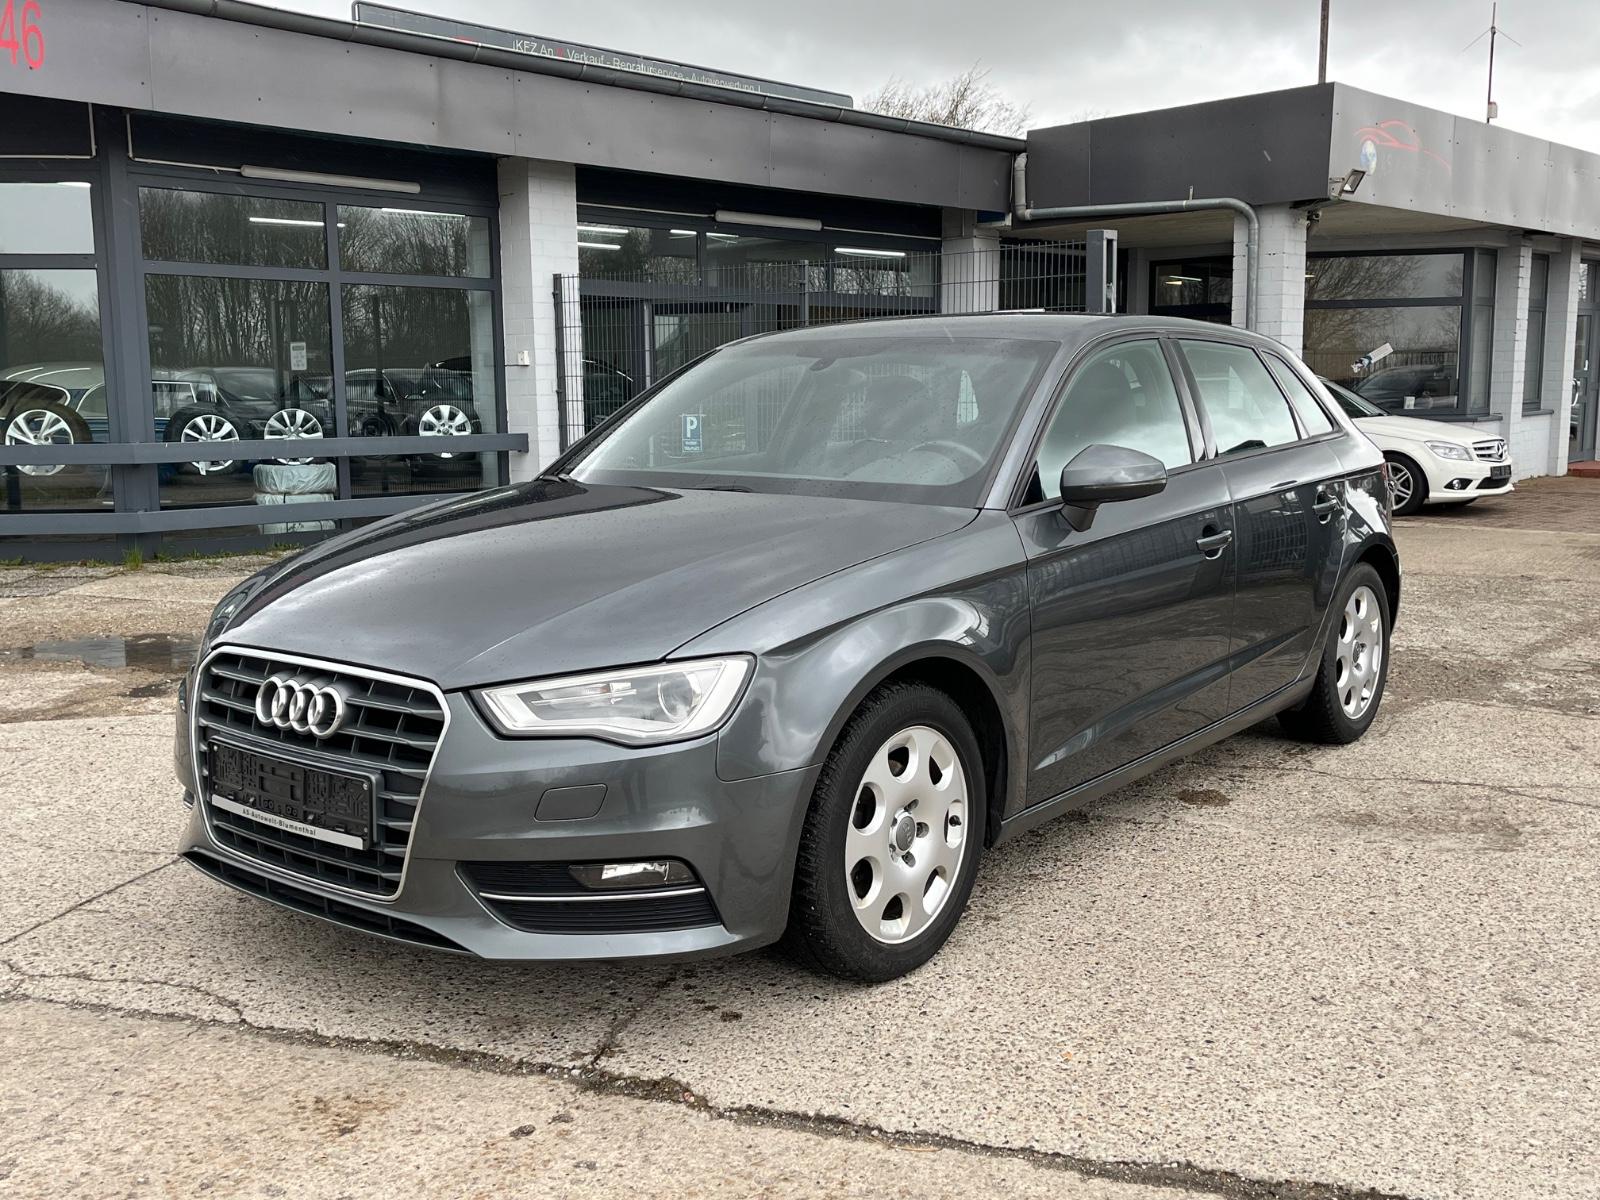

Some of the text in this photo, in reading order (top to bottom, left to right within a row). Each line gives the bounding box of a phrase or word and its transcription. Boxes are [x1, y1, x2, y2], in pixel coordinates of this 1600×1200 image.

[0, 0, 45, 70] 46
[540, 44, 554, 56] An
[686, 416, 698, 438] P
